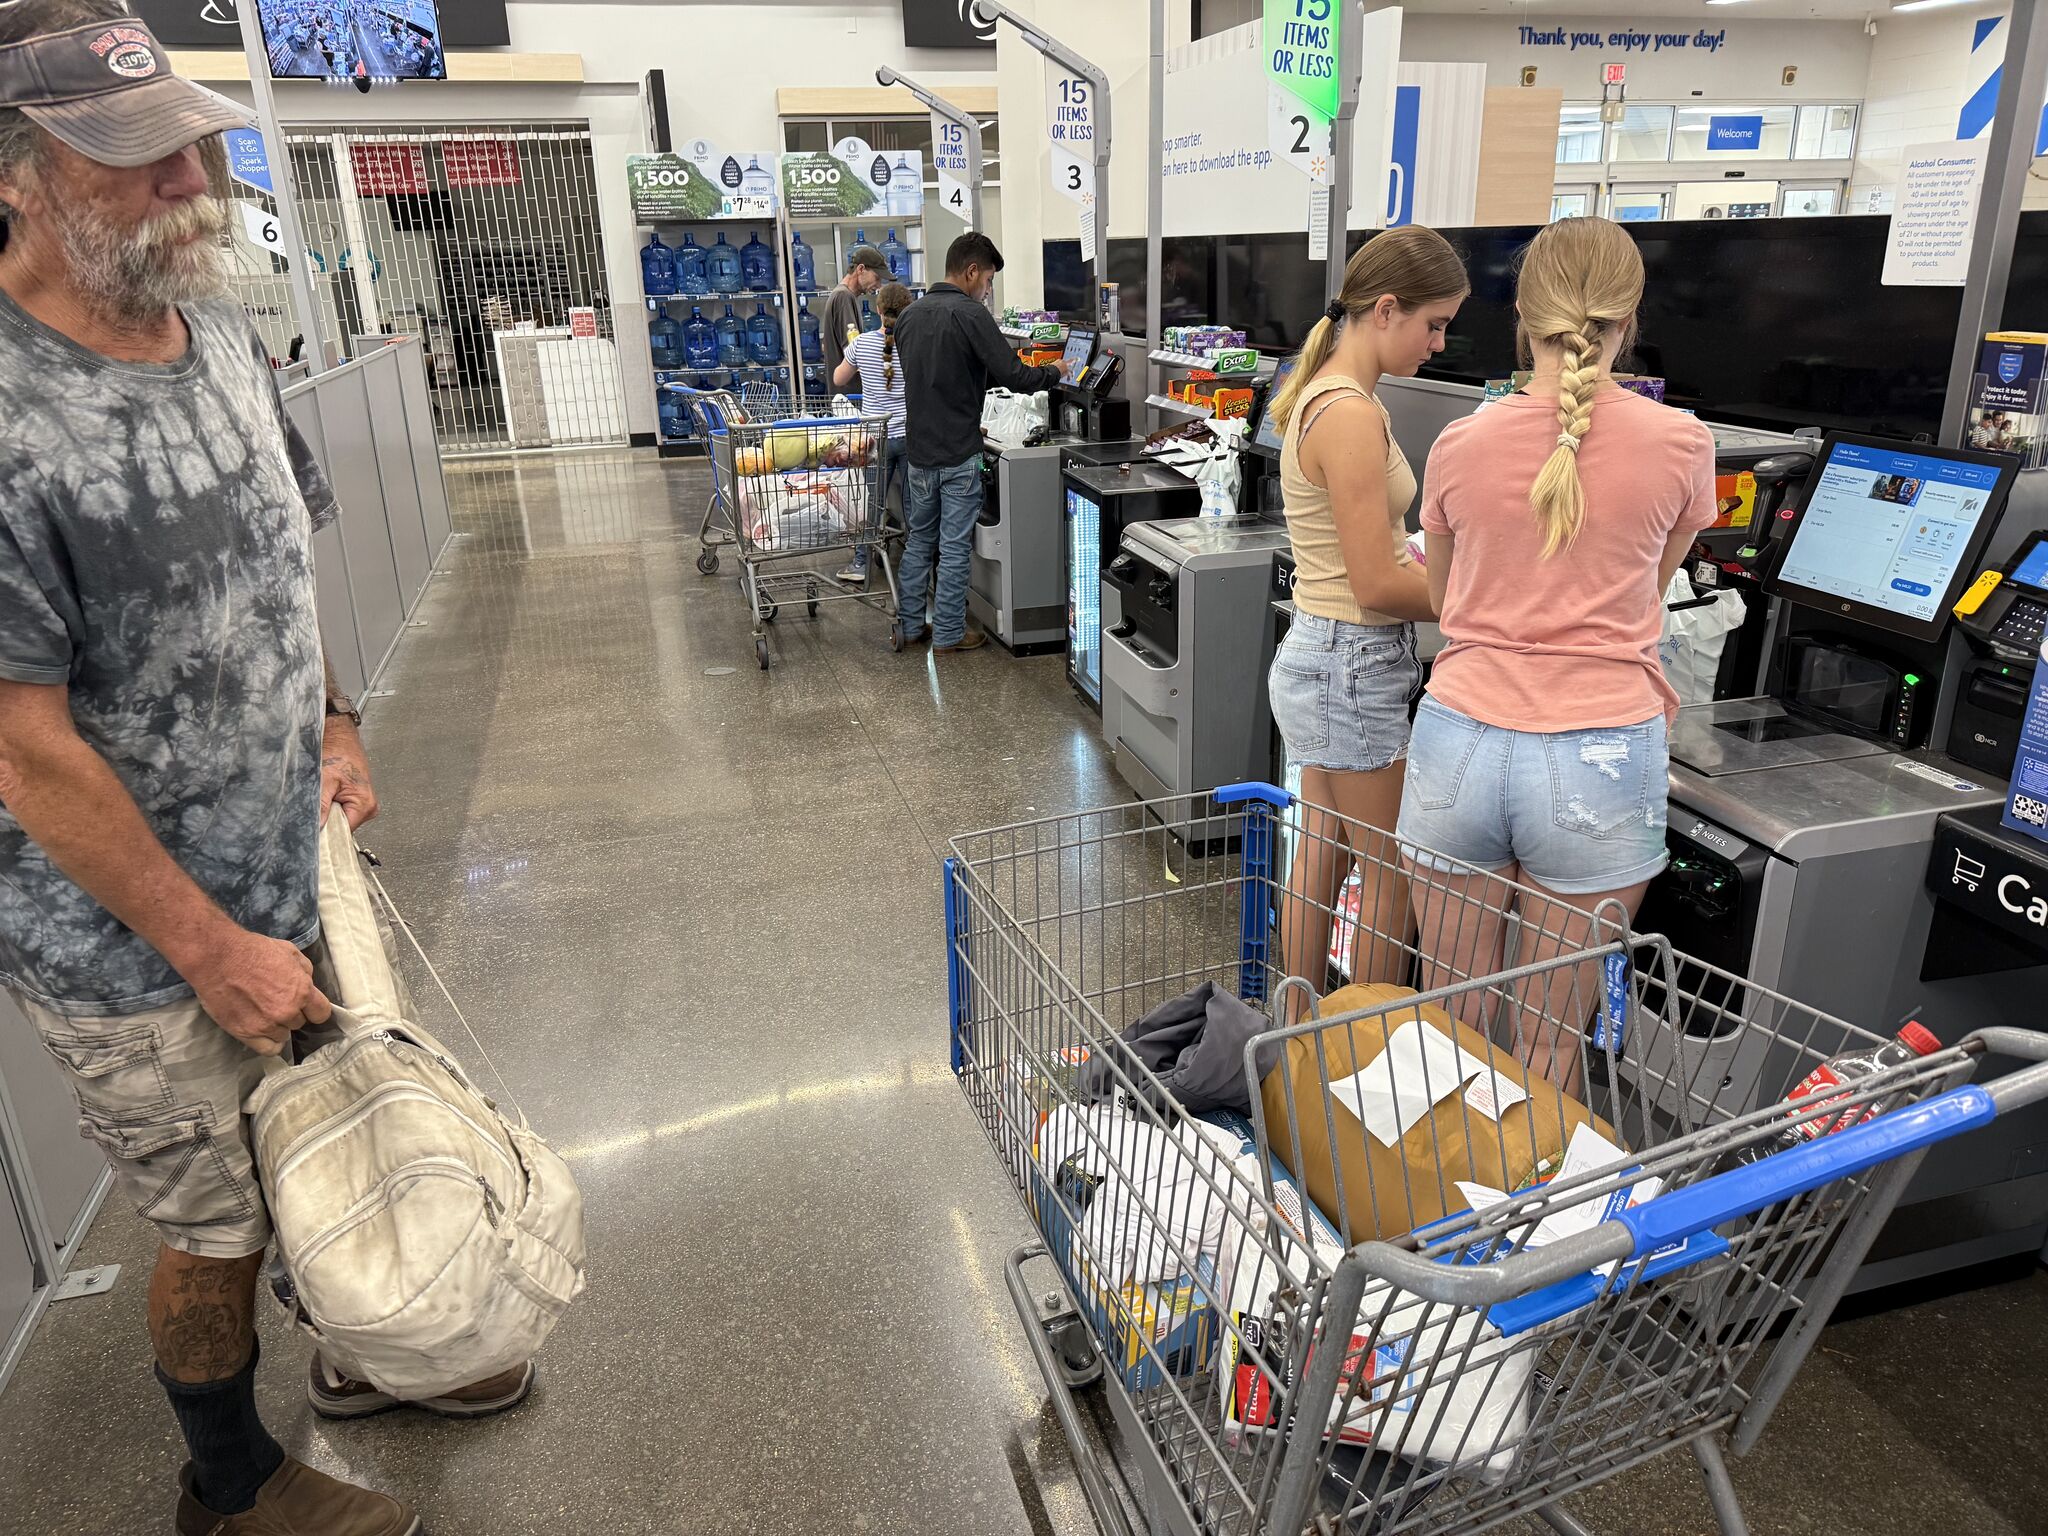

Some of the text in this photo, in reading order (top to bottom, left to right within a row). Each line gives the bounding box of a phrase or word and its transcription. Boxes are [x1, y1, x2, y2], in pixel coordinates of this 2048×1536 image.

[1295, 0, 1331, 21] 15
[1284, 22, 1329, 49] ITEMS
[1519, 26, 1725, 52] Thank you, enjoy your day!
[1273, 49, 1334, 78] OR LESS
[1607, 65, 1623, 80] EXIT
[1058, 79, 1087, 104] 15
[1057, 107, 1088, 122] ITEMS
[941, 124, 961, 142] 15
[1052, 125, 1092, 140] OR LESS
[1290, 115, 1310, 153] 2
[1717, 129, 1753, 138] Welcome
[1174, 132, 1202, 149] smarter.
[940, 144, 963, 155] ITEMS
[237, 164, 268, 173] Shopper
[240, 157, 262, 165] Spark
[936, 157, 967, 169] OR LESS
[1173, 160, 1187, 175] here
[1190, 158, 1198, 172] to
[1199, 150, 1235, 172] download
[1237, 149, 1252, 166] the
[1254, 150, 1272, 170] app.
[1910, 158, 1977, 168] Alcohol Consumer:
[634, 170, 689, 189] 1,500
[789, 168, 841, 187] 1,500
[1067, 165, 1082, 190] 3
[1946, 169, 1975, 177] appearing
[950, 188, 963, 207] 4
[1924, 201, 1940, 209] proof
[1961, 200, 1969, 208] by
[1907, 211, 1930, 219] showing
[1931, 211, 1950, 219] proper
[262, 221, 278, 243] 6
[1957, 221, 1968, 229] age
[1933, 240, 1962, 248] permitted
[1907, 250, 1933, 258] purchase
[1035, 326, 1053, 337] Extra
[1223, 355, 1247, 368] Extra
[2010, 388, 2028, 396] today
[1917, 604, 1928, 613] 0.00
[1985, 738, 1997, 746] NCR
[1702, 830, 1728, 847] NOTES
[1615, 1195, 1626, 1213] USER
